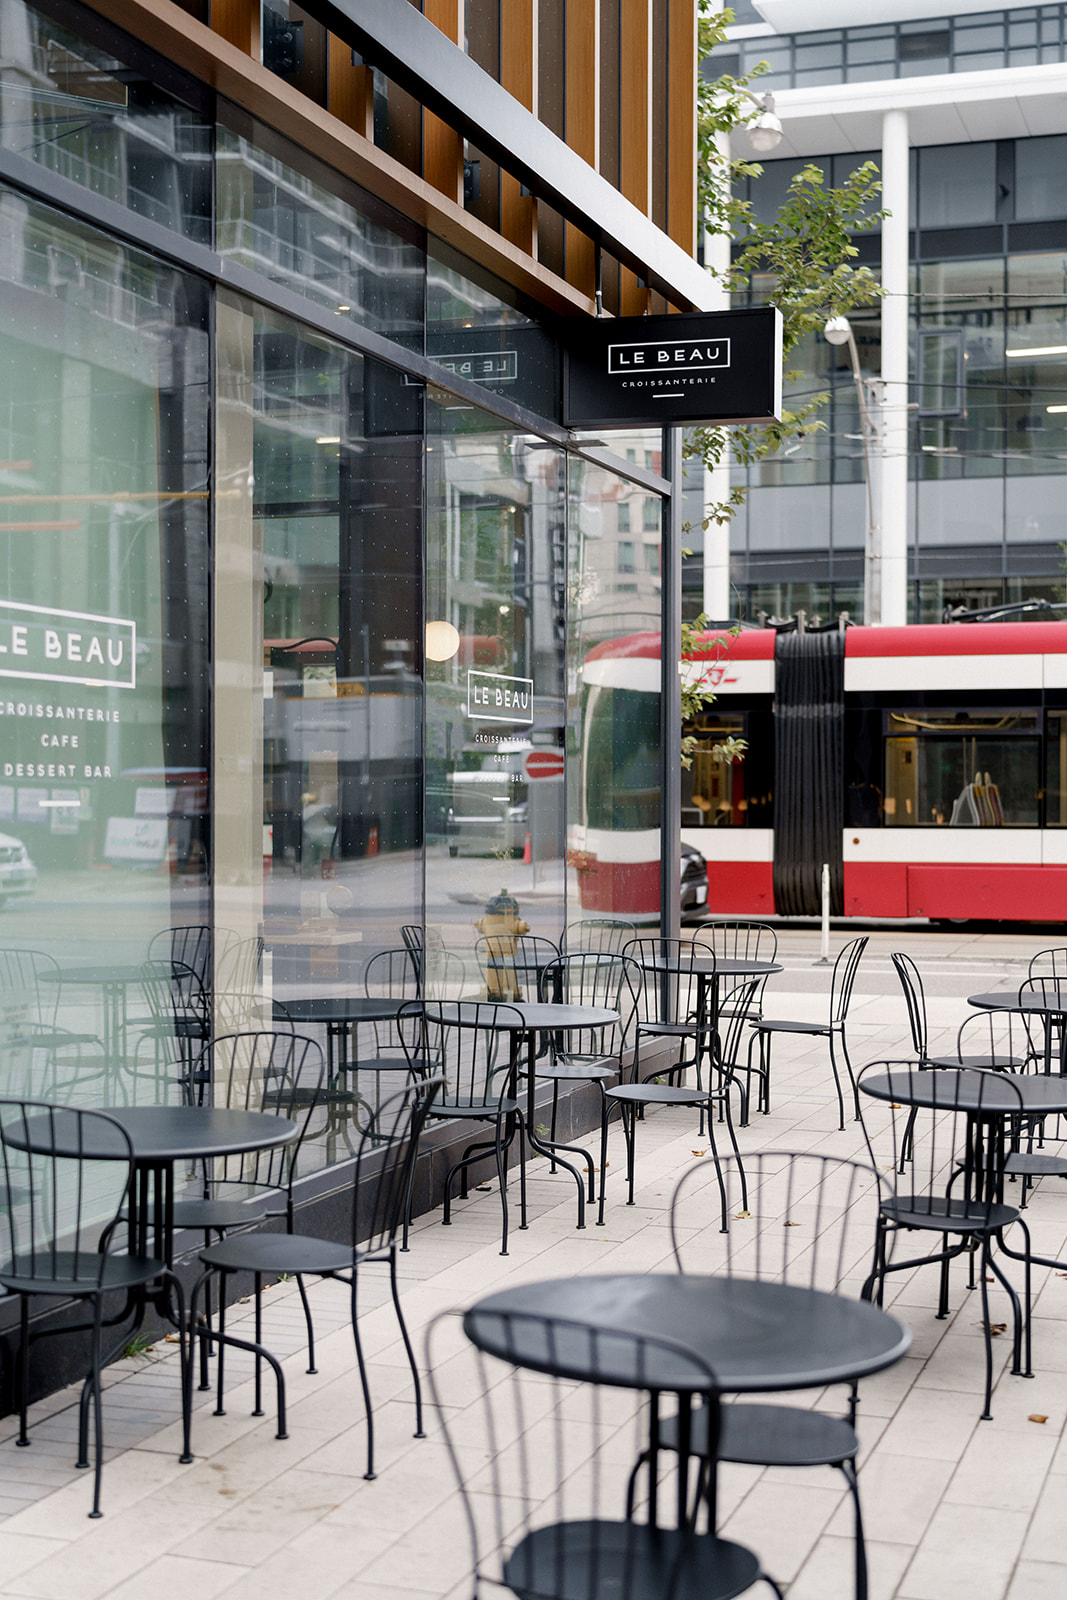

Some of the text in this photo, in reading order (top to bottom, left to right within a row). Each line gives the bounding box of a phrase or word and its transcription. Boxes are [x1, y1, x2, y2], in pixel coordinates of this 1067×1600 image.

[619, 347, 720, 365] LE BEAU
[621, 377, 717, 388] CROISSANTERIE
[45, 630, 123, 666] BEAU
[474, 685, 528, 709] LE BEAU
[40, 733, 79, 748] CAFE
[493, 755, 509, 763] CAFE
[4, 763, 112, 778] DESSERT BAR
[511, 774, 523, 782] BAR
